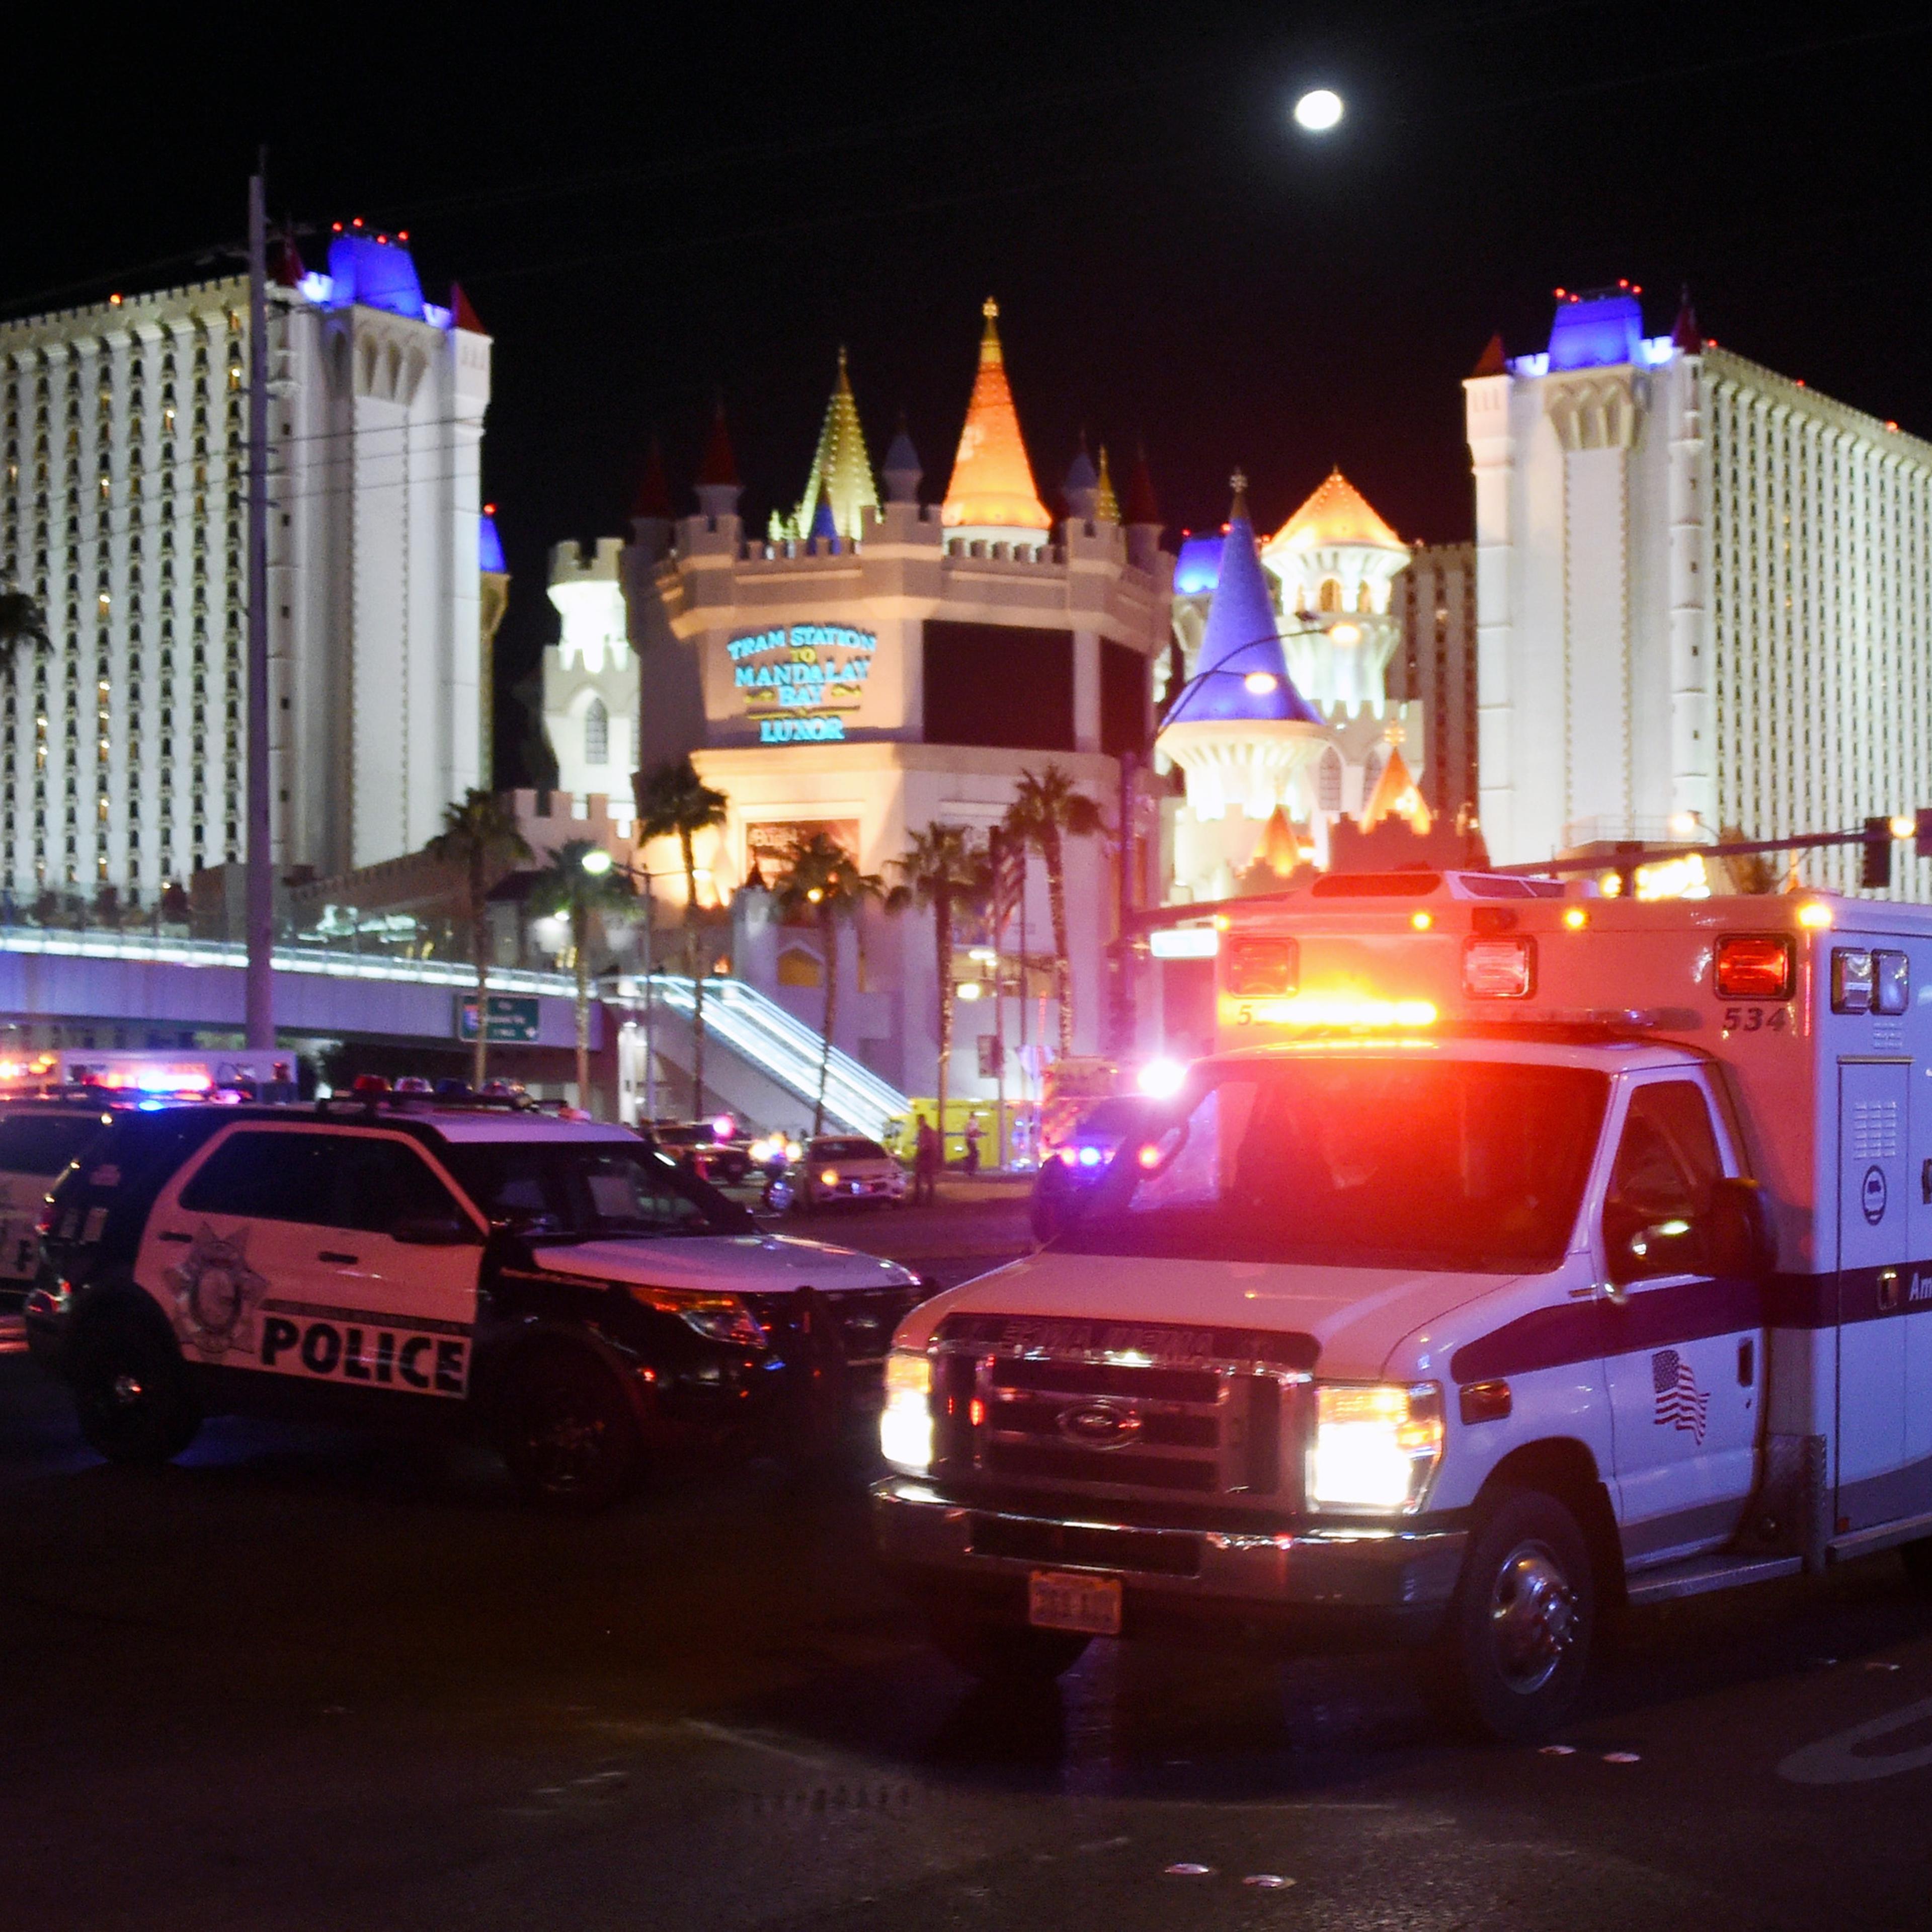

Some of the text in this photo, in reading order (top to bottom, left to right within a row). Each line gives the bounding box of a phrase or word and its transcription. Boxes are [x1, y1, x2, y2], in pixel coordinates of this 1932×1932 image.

[727, 626, 876, 660] TRAM STATION
[791, 648, 816, 663] TO
[735, 660, 869, 687] MANDALAY
[779, 684, 823, 706] BAY
[761, 717, 844, 742] LUXOR
[1723, 1007, 1786, 1031] 534
[262, 1317, 465, 1392] POLICE
